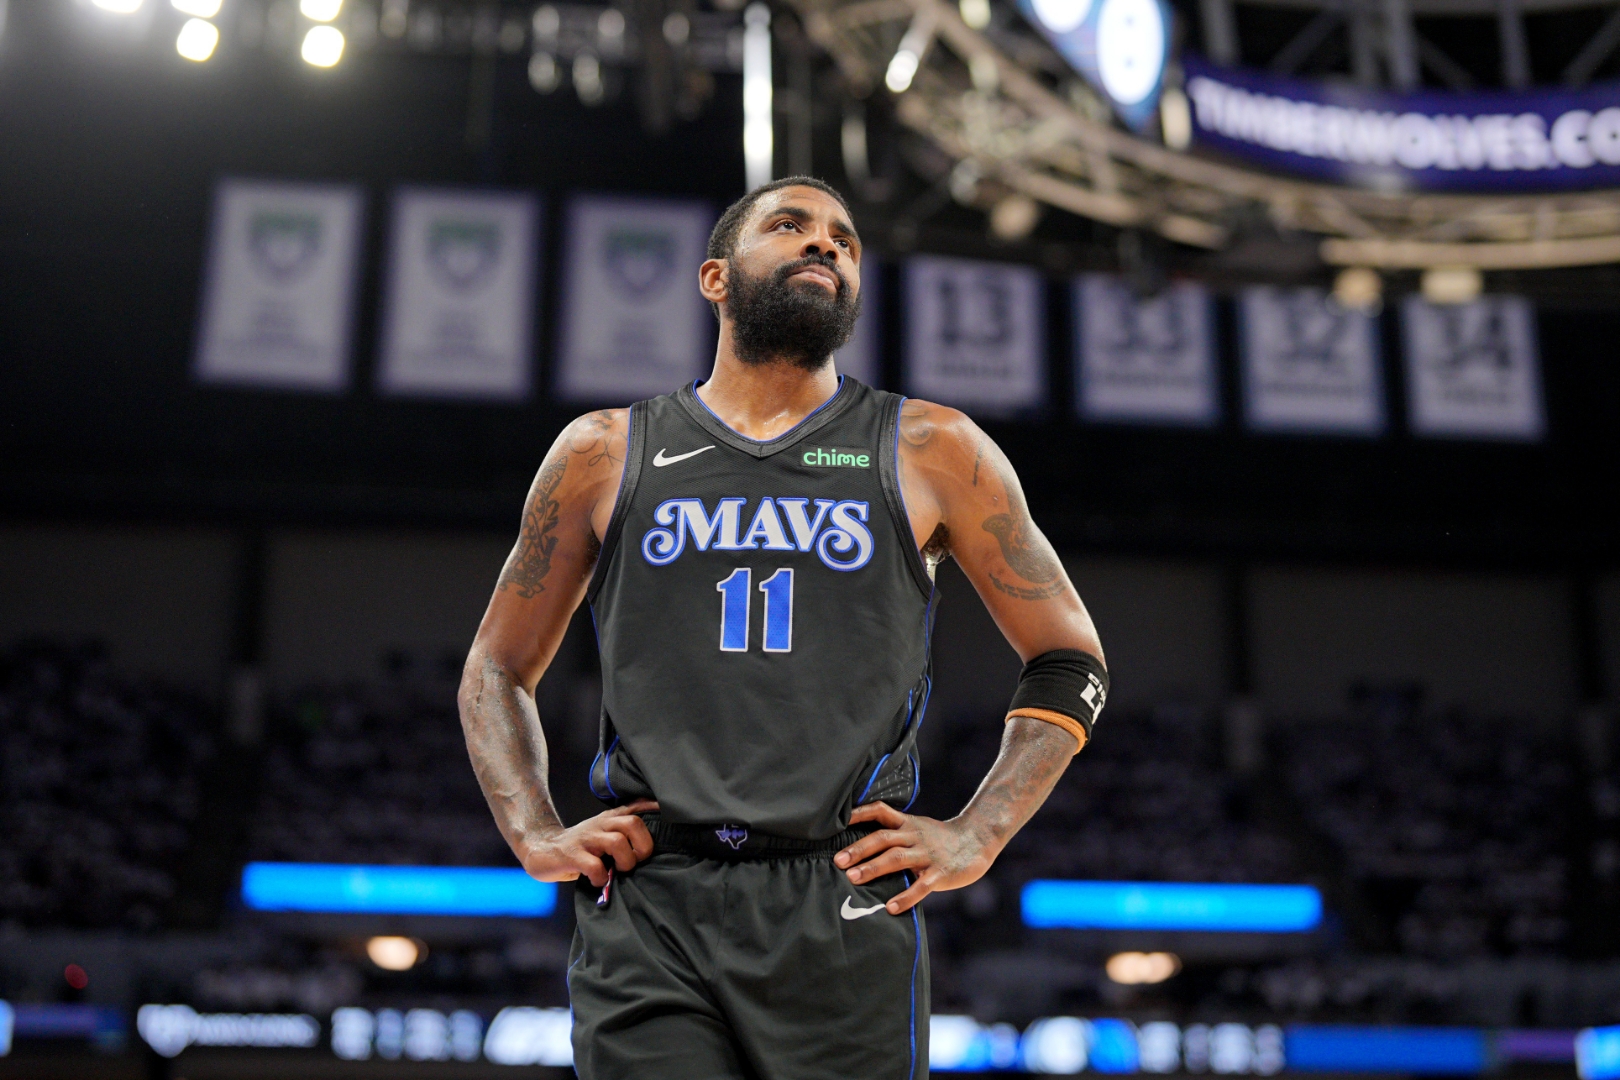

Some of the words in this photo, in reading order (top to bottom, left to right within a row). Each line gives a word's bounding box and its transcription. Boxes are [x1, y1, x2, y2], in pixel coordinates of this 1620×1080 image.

[803, 448, 870, 467] chime
[641, 496, 875, 572] MAVS
[716, 567, 795, 653] 11
